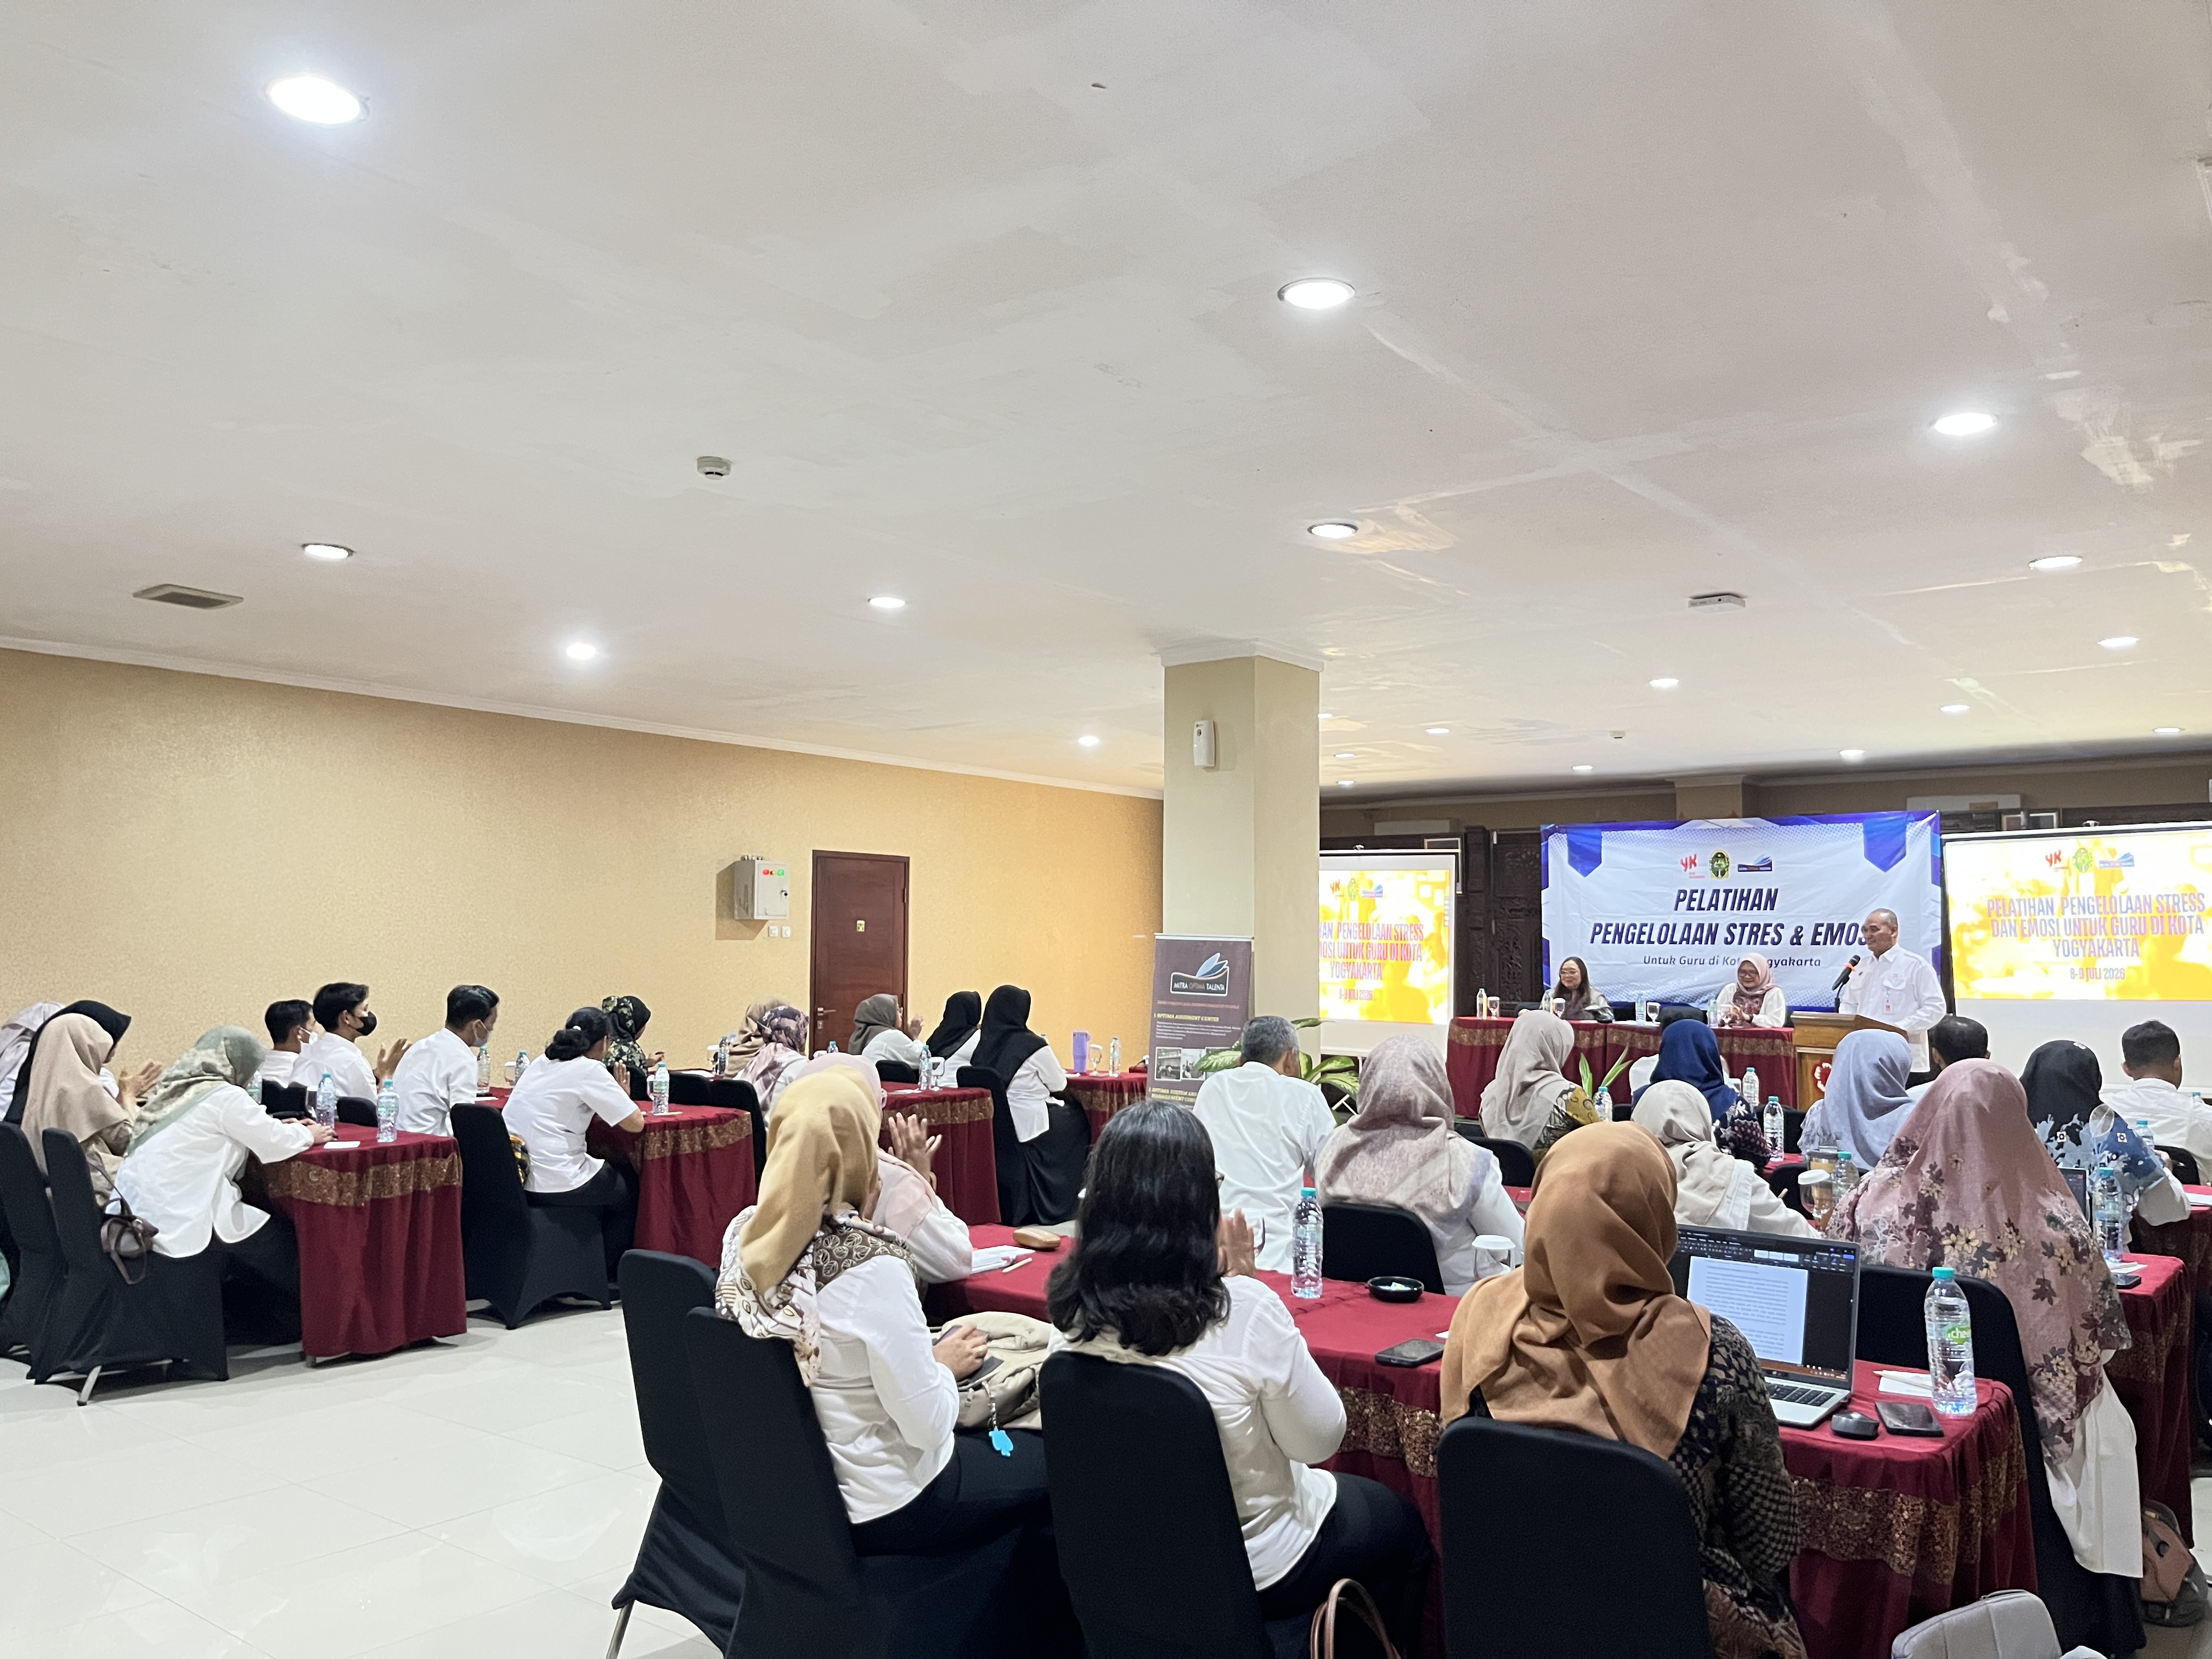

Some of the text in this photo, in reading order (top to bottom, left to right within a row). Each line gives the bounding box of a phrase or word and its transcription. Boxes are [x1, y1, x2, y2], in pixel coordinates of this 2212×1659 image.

[1674, 888, 1779, 911] PELATIHAN
[1987, 893, 2205, 917] PELATIHAN PENGELOLAAN STRESS
[1337, 922, 1392, 941] PENGELOLAAN
[1394, 923, 1424, 941] STRESS
[1590, 922, 1719, 945] PENGELOLAAN
[1724, 923, 1785, 946] STRES
[1790, 925, 1804, 946] &
[1991, 915, 2204, 938] DAN EMOSI UNTUK GURU DI KOTA
[1338, 942, 1364, 960] UNTUK
[1366, 943, 1388, 960] GURU
[1390, 943, 1398, 961] DI
[1401, 943, 1423, 961] KOTA
[2053, 938, 2140, 957] YOGYAKARTA
[1644, 956, 1675, 965] Untuk
[1679, 956, 1705, 966] Guru
[1708, 955, 1719, 966] di
[1330, 961, 1383, 980] YOGYAKARTA
[2086, 968, 2101, 982] JULI
[2103, 967, 2125, 980] 2026
